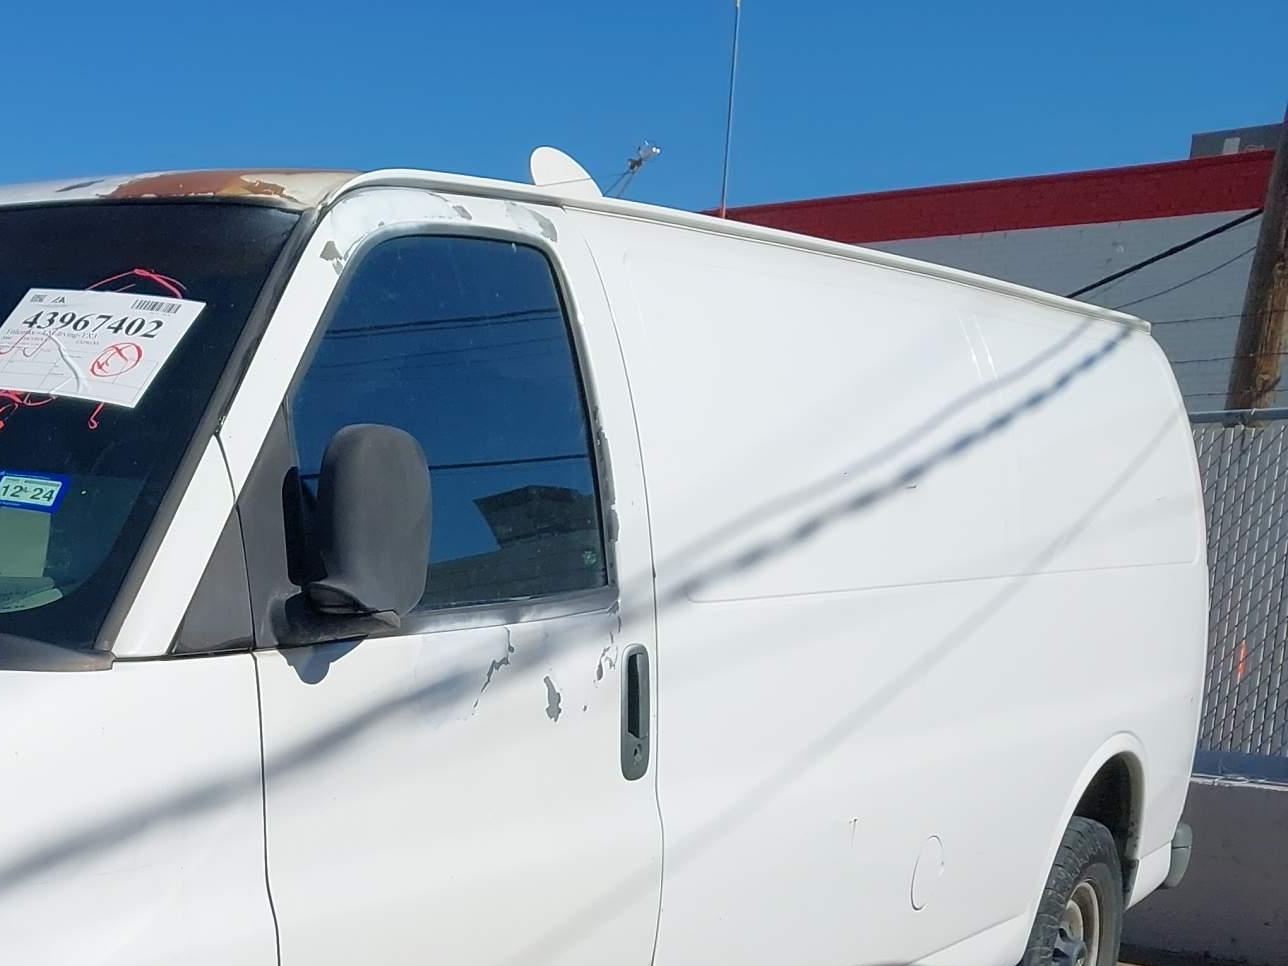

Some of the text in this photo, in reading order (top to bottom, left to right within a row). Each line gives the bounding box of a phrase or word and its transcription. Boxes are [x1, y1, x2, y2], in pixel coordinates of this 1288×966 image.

[22, 310, 164, 340] 43967402
[2, 484, 55, 502] 12 24
